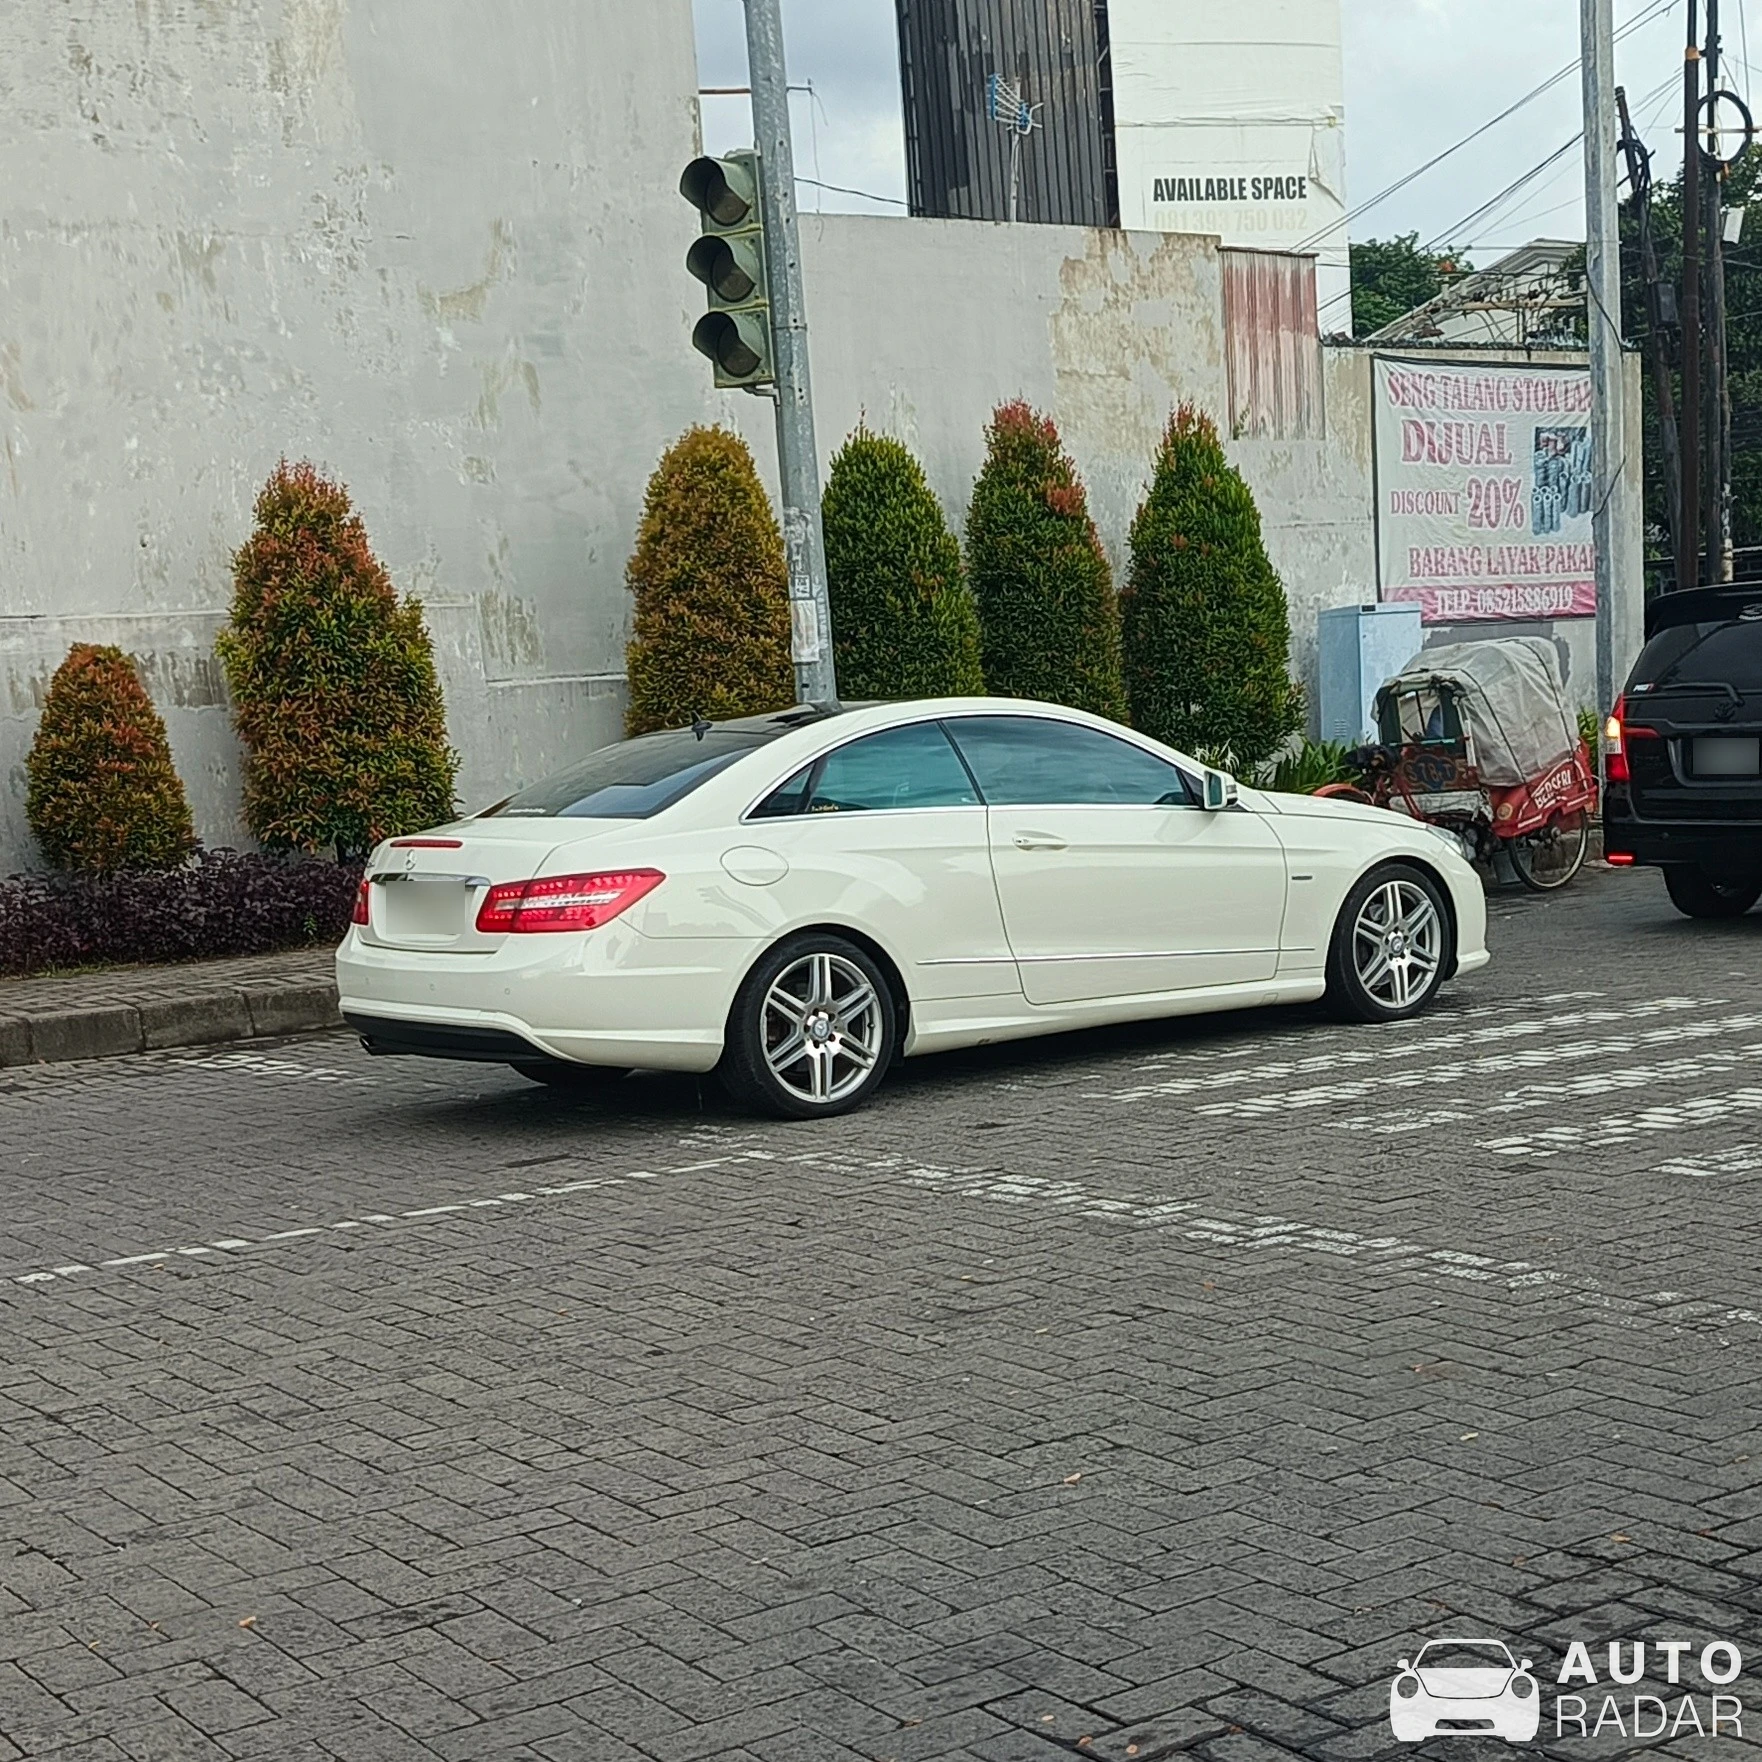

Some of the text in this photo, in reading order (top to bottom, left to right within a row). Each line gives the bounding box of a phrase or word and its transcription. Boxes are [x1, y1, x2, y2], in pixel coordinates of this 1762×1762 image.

[1153, 176, 1307, 202] AVAILABLE SPACE
[1233, 208, 1267, 232] 750
[1272, 207, 1308, 231] 032
[1388, 371, 1436, 409] SENG
[1440, 375, 1507, 411] TALANG
[1512, 377, 1559, 413] STOK
[1401, 419, 1513, 466] DIJUAL
[1390, 477, 1525, 529] DISCOUNT 20%
[1409, 546, 1482, 578] BARANG
[1486, 544, 1541, 576] LAYAK
